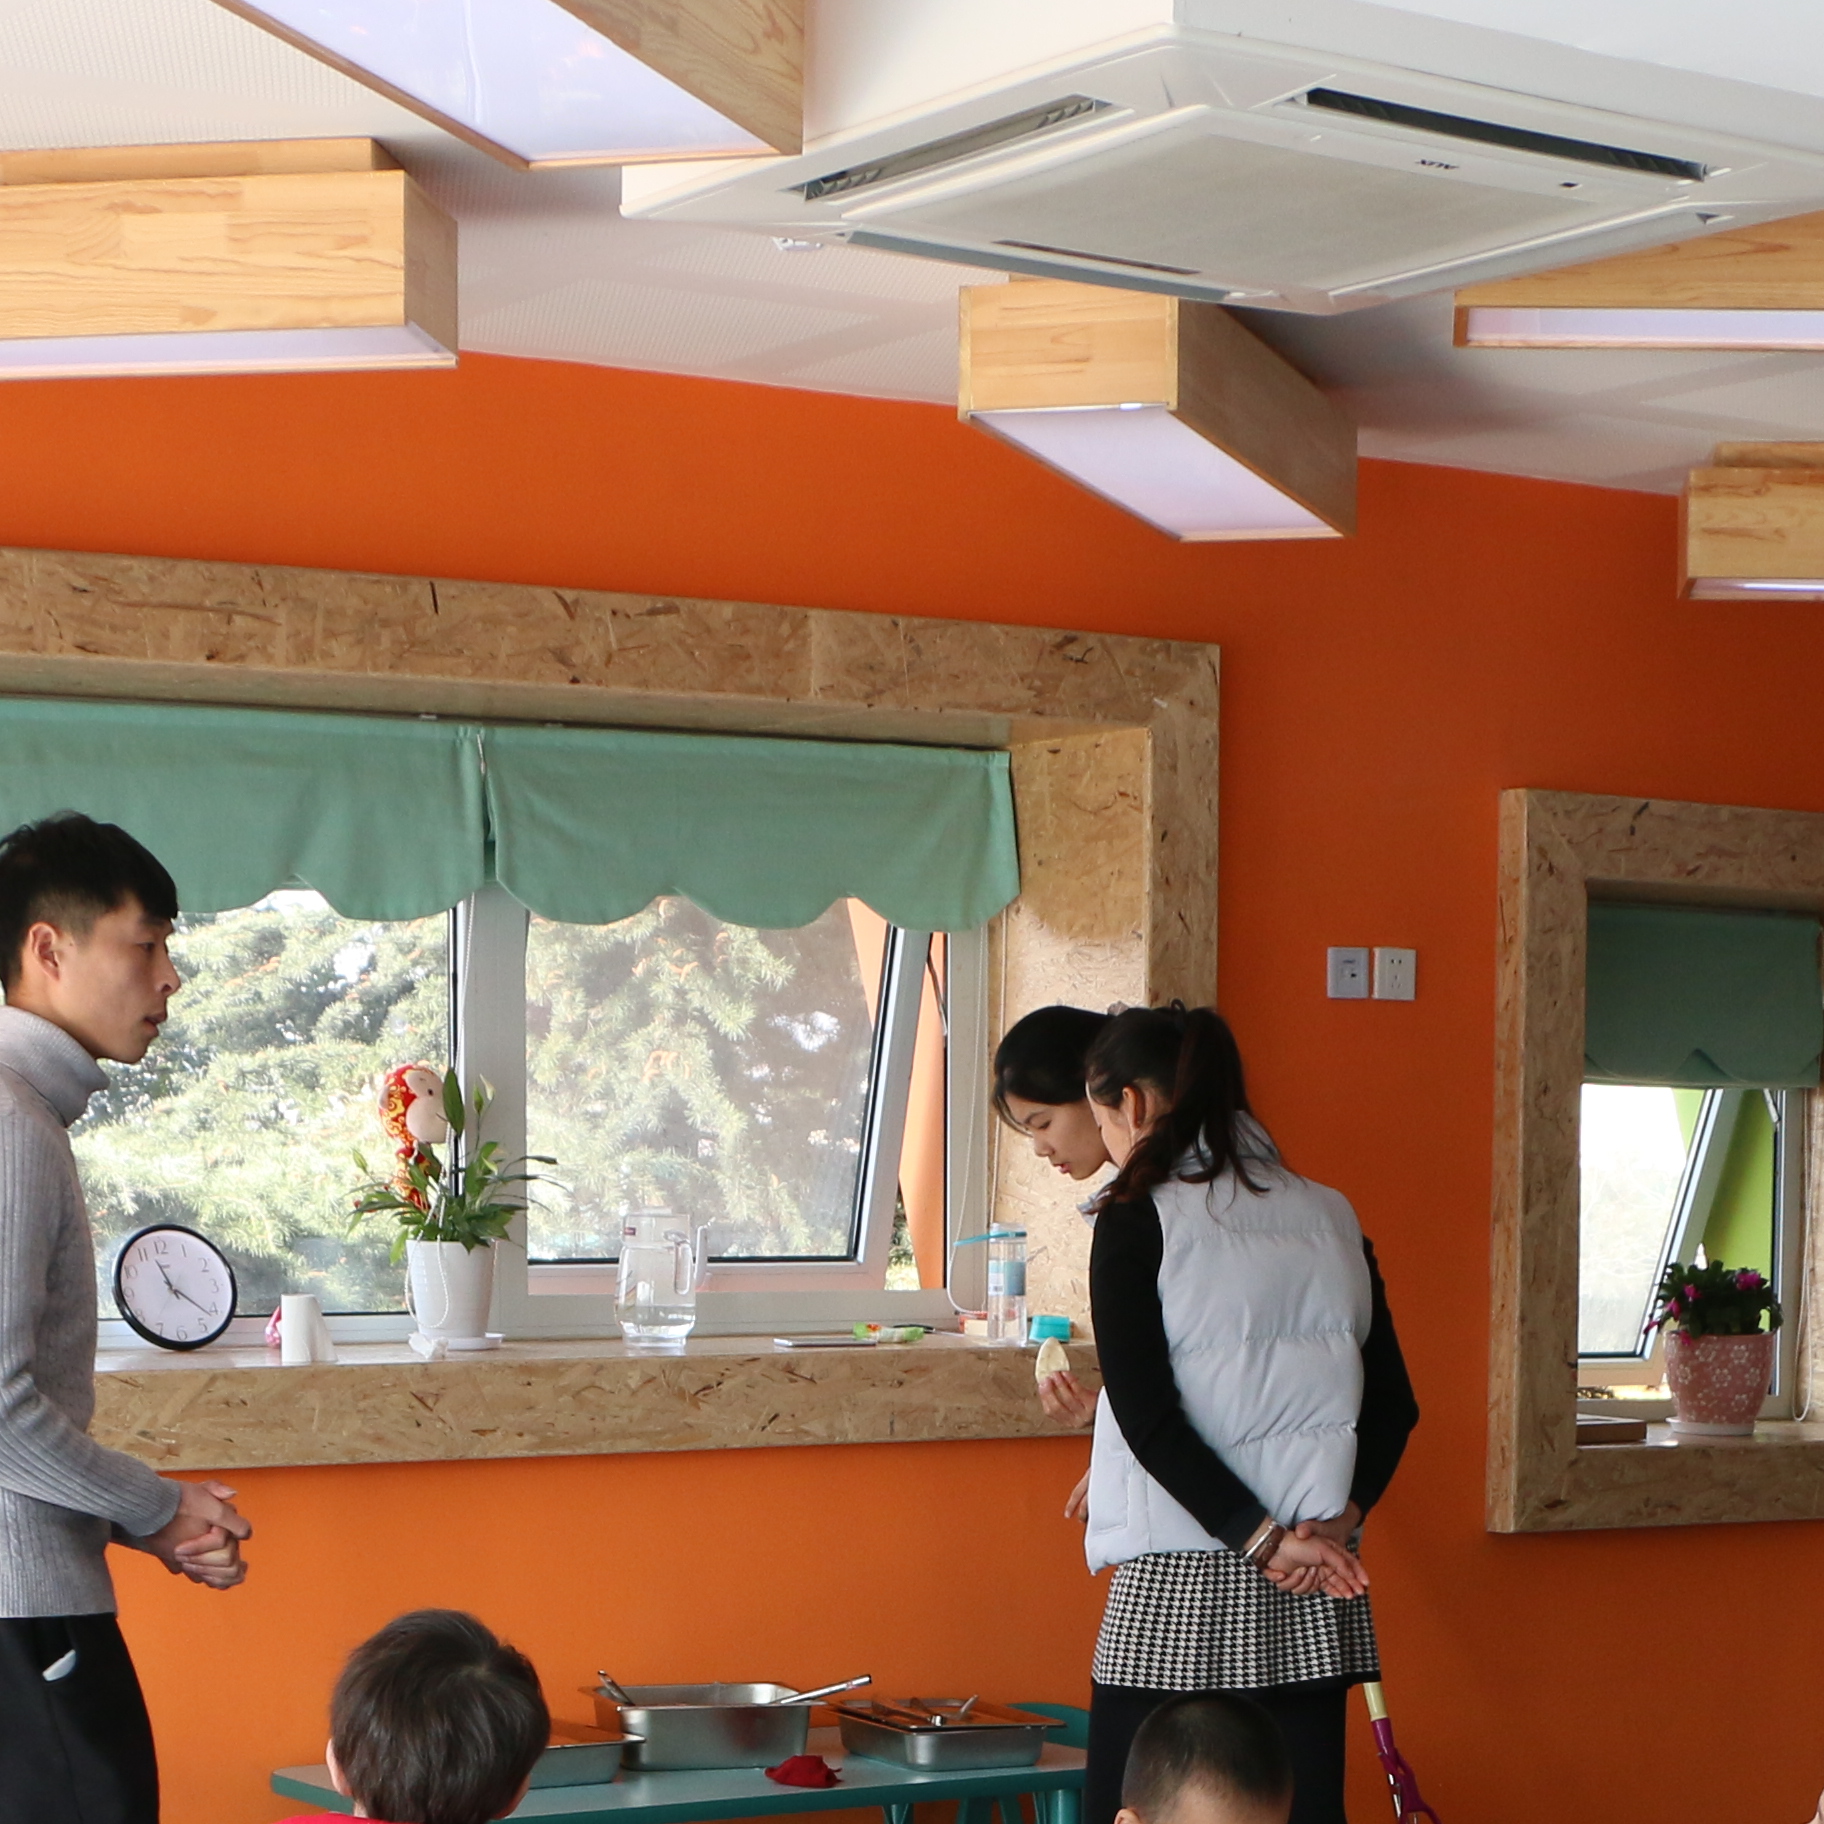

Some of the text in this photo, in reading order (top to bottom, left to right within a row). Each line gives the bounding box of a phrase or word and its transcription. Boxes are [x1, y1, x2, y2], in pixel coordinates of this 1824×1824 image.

[137, 1247, 149, 1262] 11
[154, 1240, 169, 1255] 12
[181, 1243, 187, 1258] 1
[124, 1264, 138, 1280] 10
[198, 1257, 210, 1273] 2
[209, 1279, 220, 1294] 3
[209, 1302, 219, 1316] 4
[197, 1317, 208, 1333] 5
[176, 1325, 188, 1341] 6
